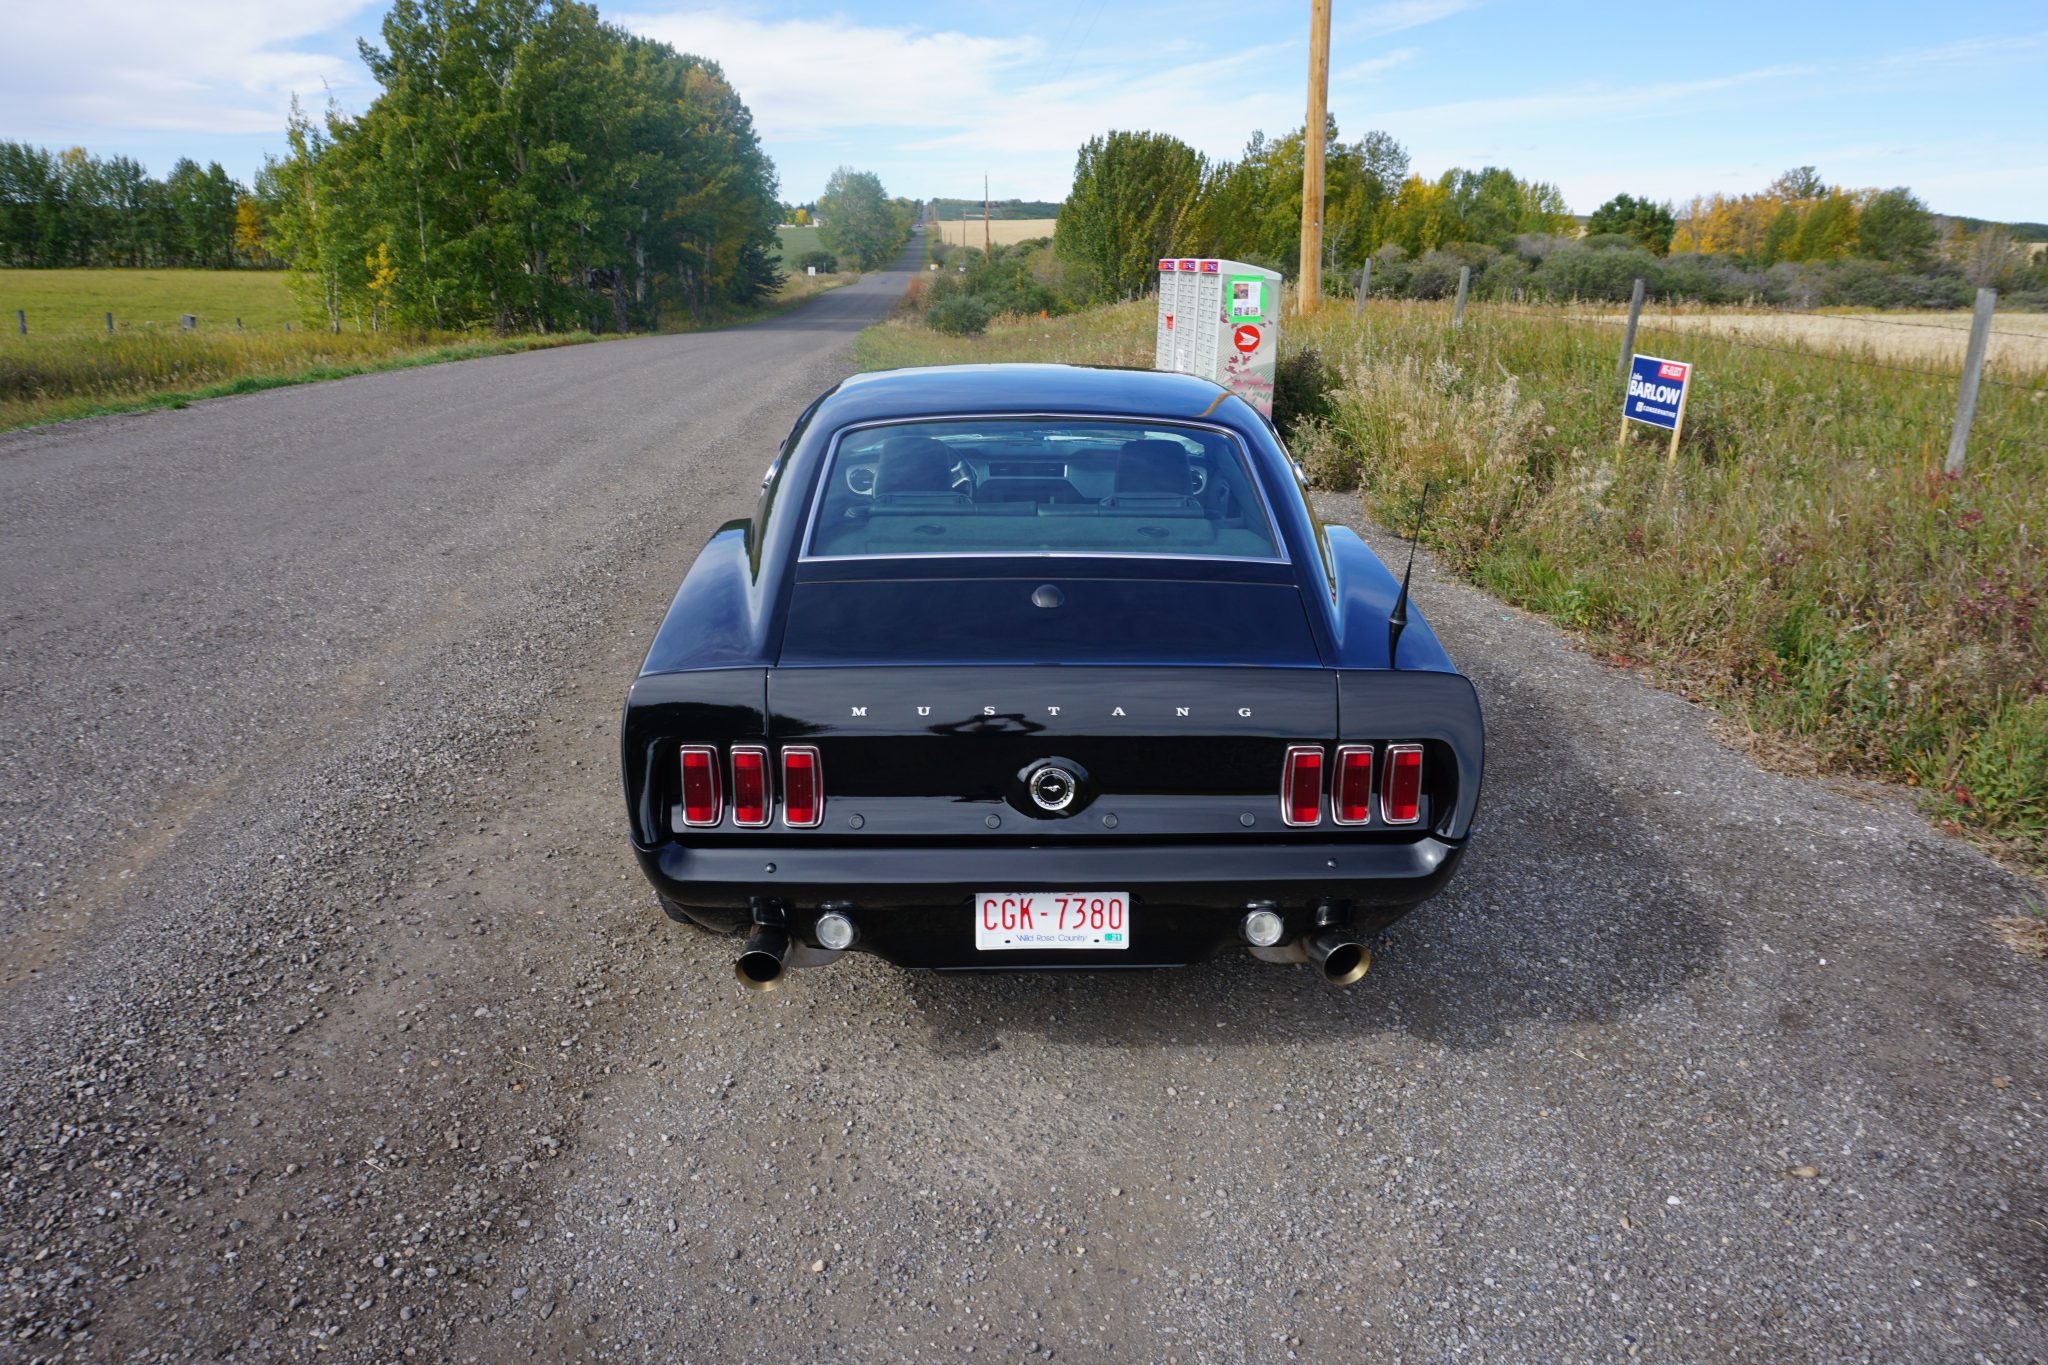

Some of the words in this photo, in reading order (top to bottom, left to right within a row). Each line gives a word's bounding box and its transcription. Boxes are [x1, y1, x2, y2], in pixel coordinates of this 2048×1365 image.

[1629, 380, 1681, 405] BARLOW
[851, 706, 1252, 718] MUSTANG
[1016, 934, 1034, 942] Wild
[1036, 934, 1055, 942] Rose
[1057, 934, 1088, 943] Country
